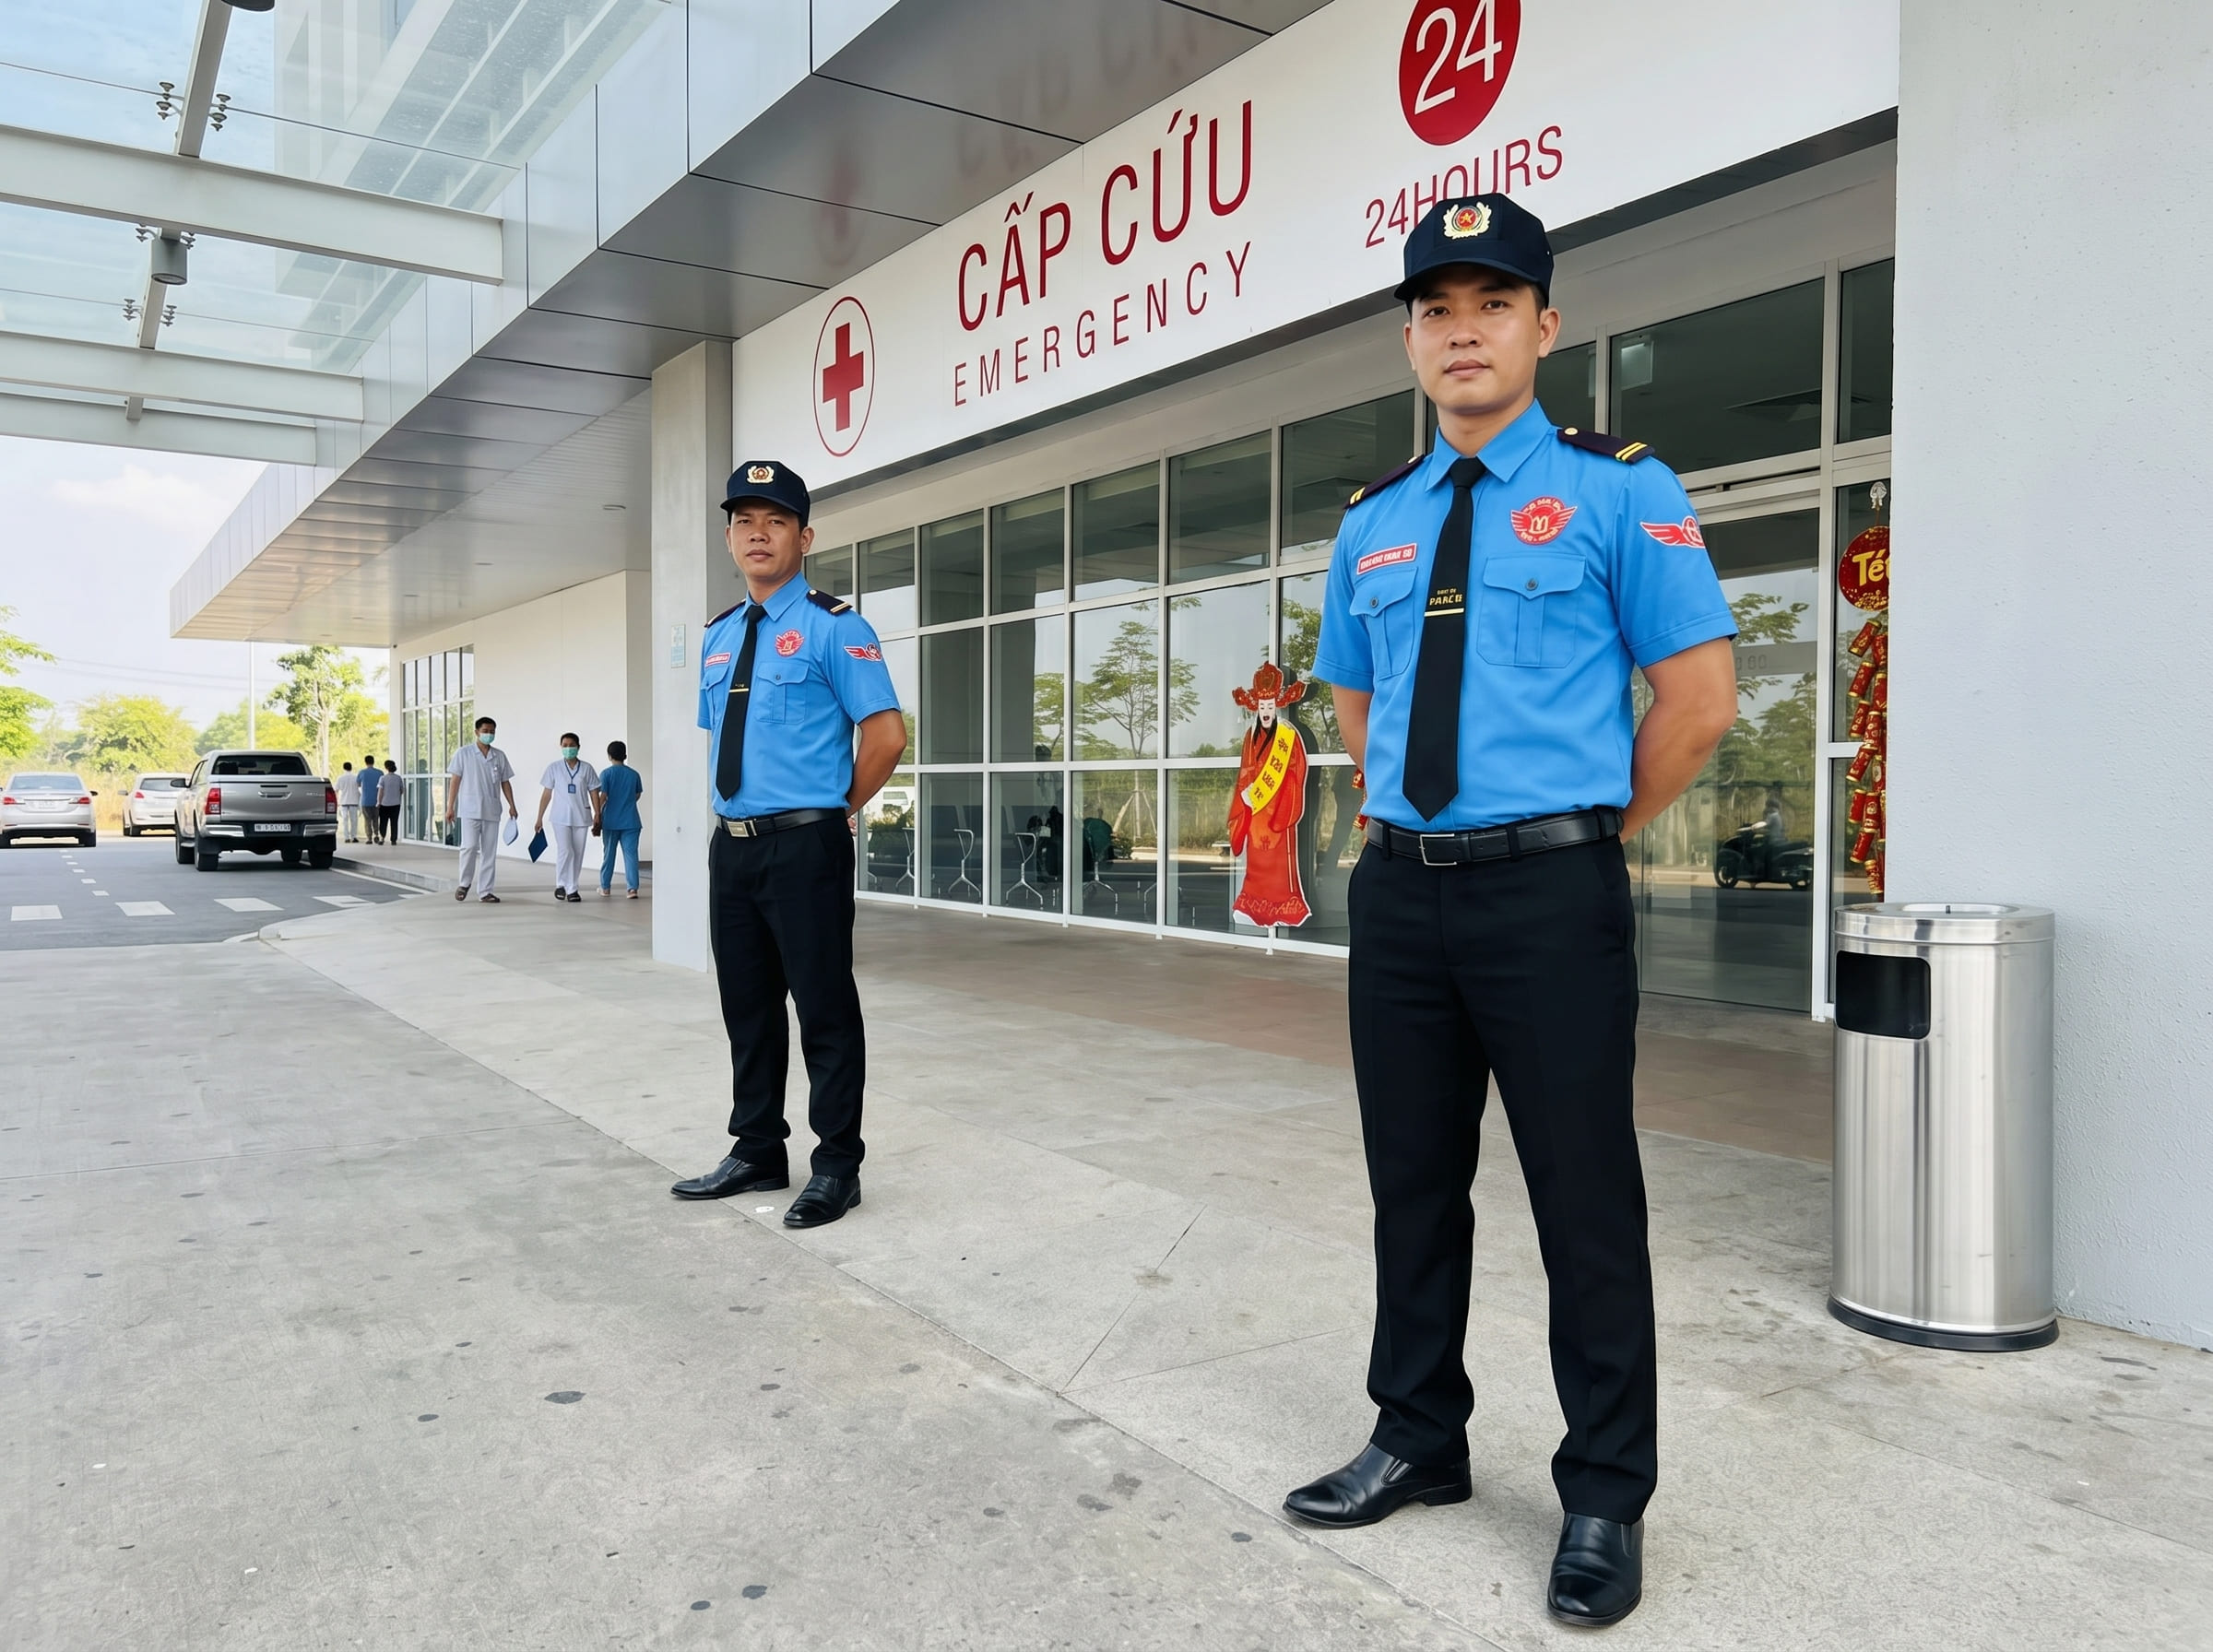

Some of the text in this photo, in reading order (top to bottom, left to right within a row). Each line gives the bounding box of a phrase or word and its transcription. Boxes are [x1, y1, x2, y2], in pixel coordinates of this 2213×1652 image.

[1414, 0, 1503, 115] 24
[958, 100, 1252, 332] CẤP CỨU
[954, 241, 1252, 407] EMERGENCY
